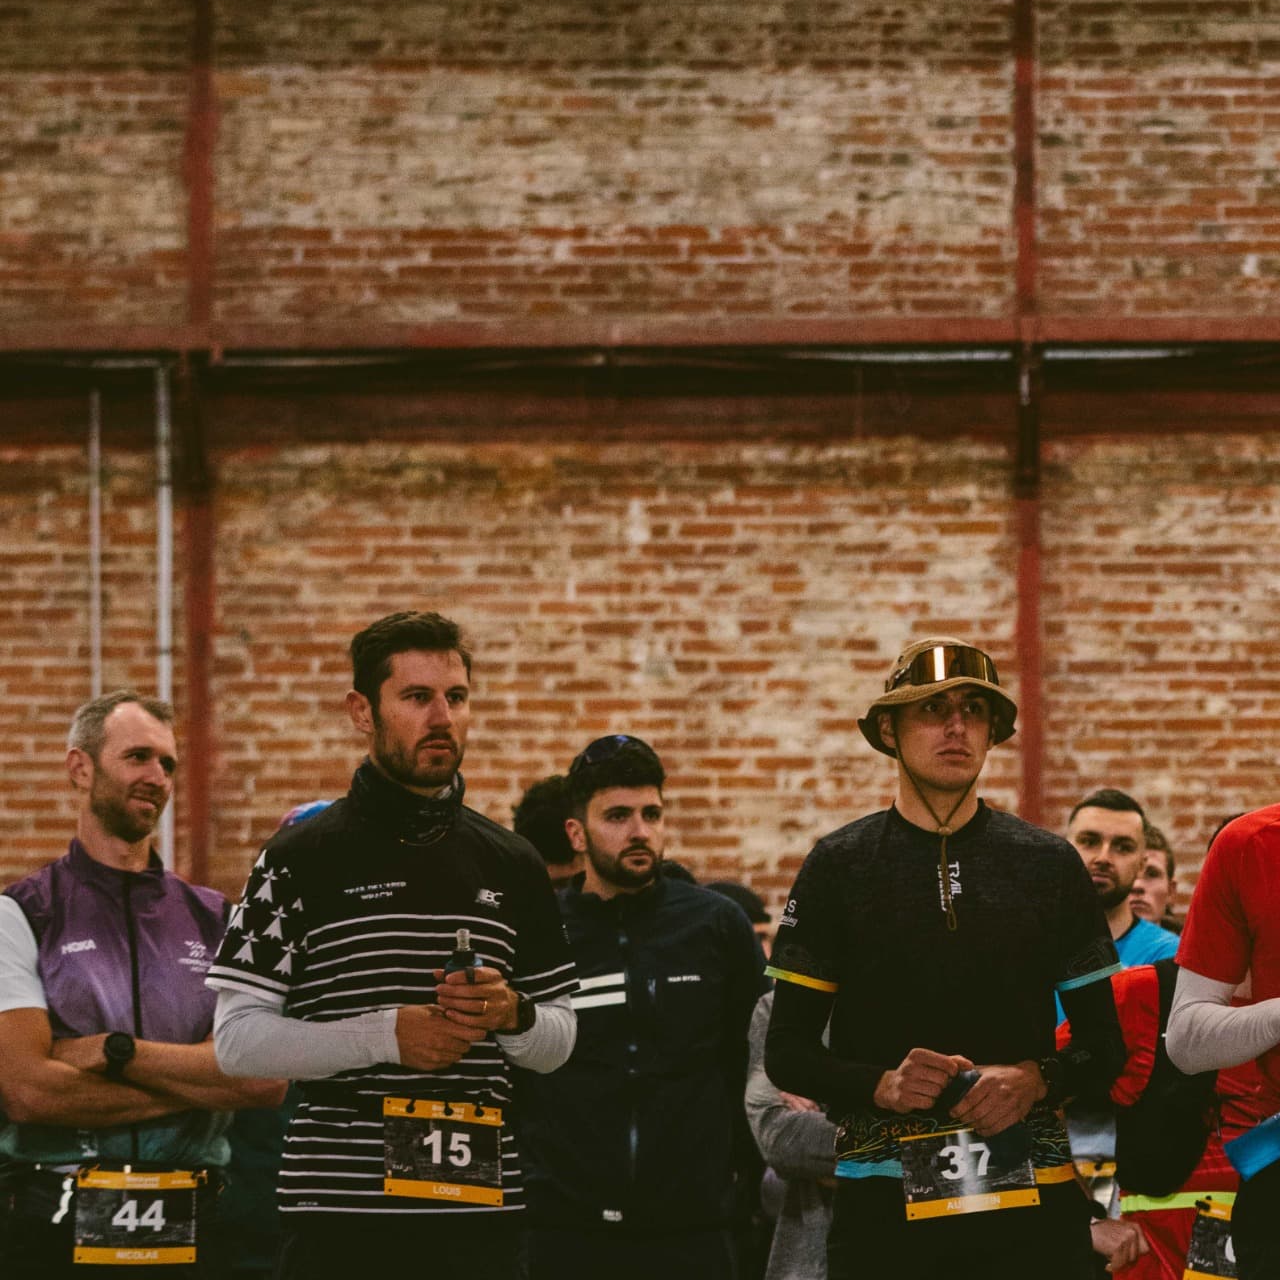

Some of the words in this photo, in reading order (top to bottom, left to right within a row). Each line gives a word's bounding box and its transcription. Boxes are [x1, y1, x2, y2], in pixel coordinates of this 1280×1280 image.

[61, 939, 97, 955] HOKA
[423, 1130, 472, 1168] 15
[939, 1142, 991, 1180] 37
[432, 1185, 462, 1197] LOUIS
[111, 1199, 166, 1232] 44
